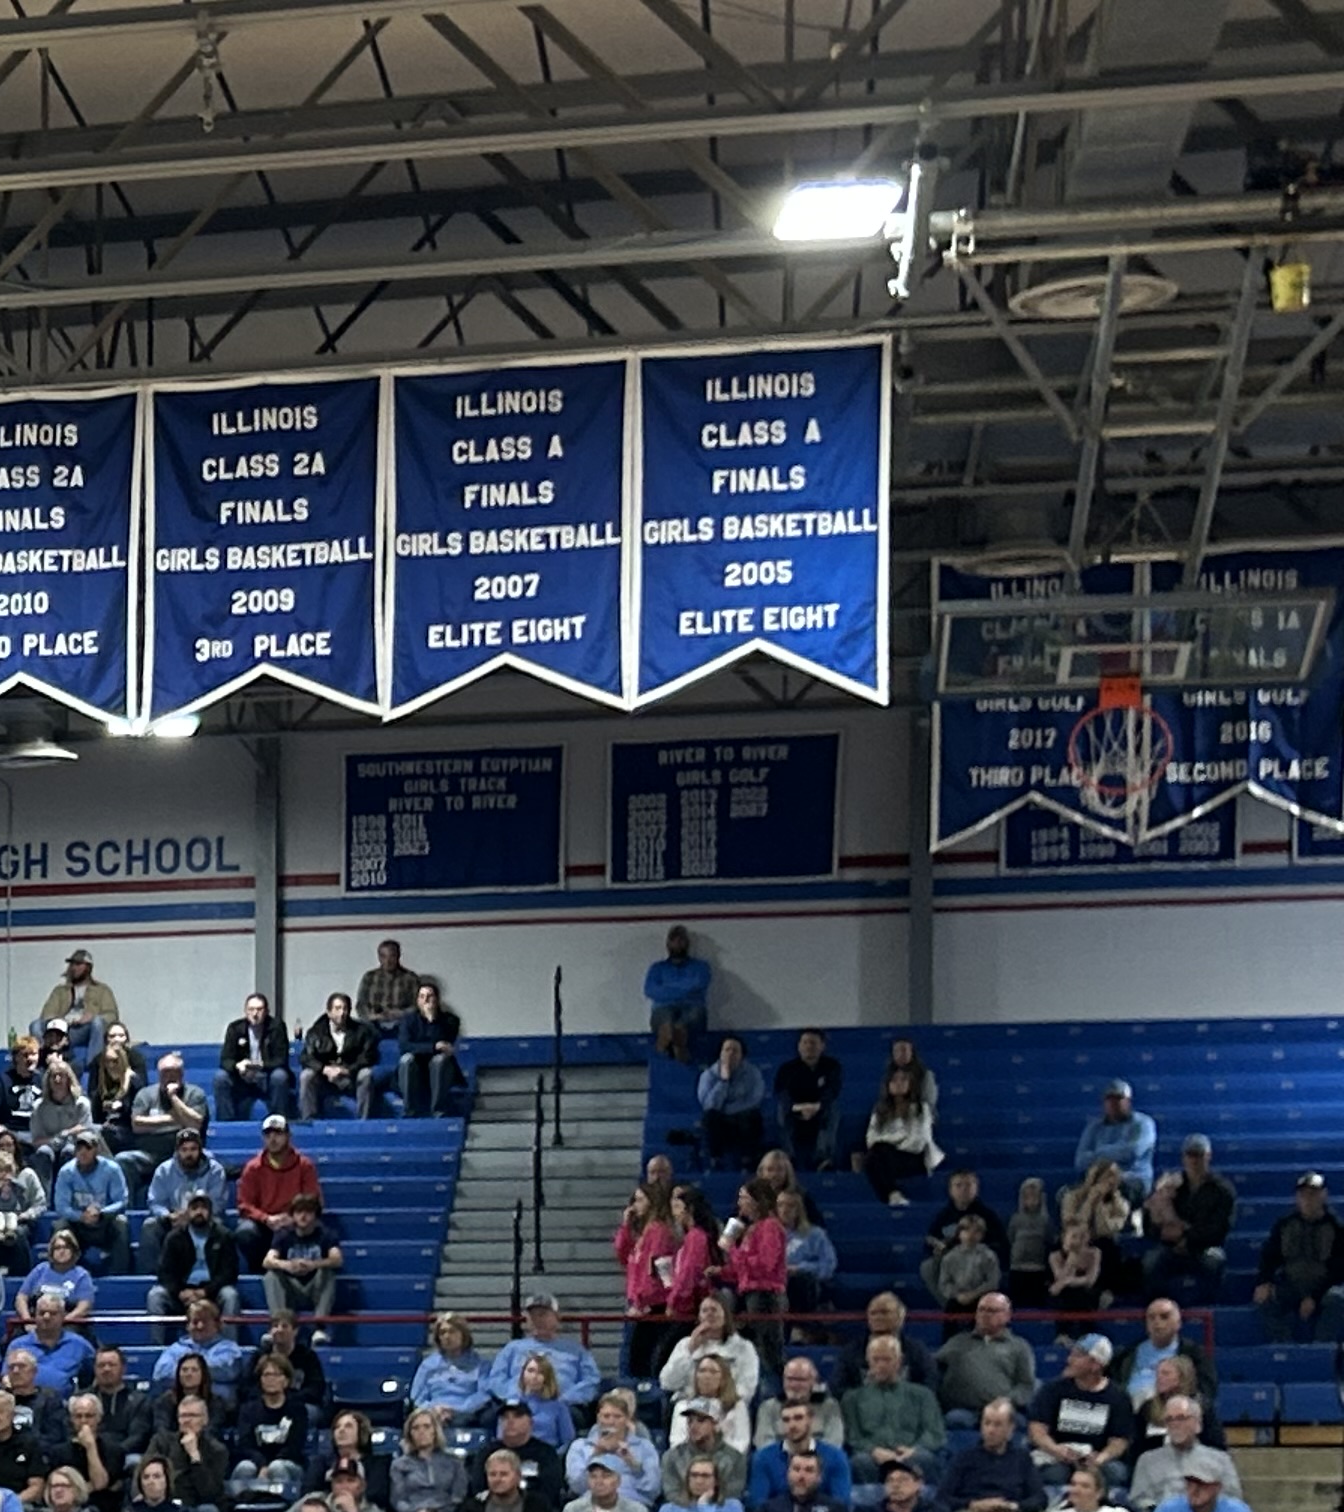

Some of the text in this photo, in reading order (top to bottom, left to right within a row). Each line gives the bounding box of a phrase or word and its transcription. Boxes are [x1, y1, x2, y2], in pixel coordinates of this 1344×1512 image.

[706, 372, 815, 402] ILLINOIS
[456, 389, 564, 419] ILLINOIS
[212, 406, 318, 435] ILLINOIS
[701, 418, 821, 449] CLASS A
[452, 435, 564, 465] CLASS A
[53, 465, 84, 488] 2A
[202, 452, 326, 482] CLASS 2A
[712, 466, 805, 495] FINALS
[464, 481, 555, 508] FINALS
[220, 498, 309, 525] FINALS
[396, 522, 621, 557] GIRLS BASKETBALL
[644, 509, 877, 545] GIRLS BASKETBALL
[156, 538, 373, 571] GIRLS BASKETBALL
[474, 574, 540, 600] 2007
[724, 560, 792, 587] 2005
[231, 589, 295, 614] 2009
[428, 615, 586, 649] ELITE EIGHT
[679, 604, 839, 636] ELITE EIGHT
[23, 631, 99, 656] PLACE
[195, 632, 331, 661] 3RD PLACE
[1008, 727, 1058, 750] 2017
[1220, 720, 1272, 744] 2016
[969, 764, 1084, 788] THIRD PLAC
[1166, 757, 1330, 784] SECOND PLACE
[65, 836, 240, 878] SCHOOL
